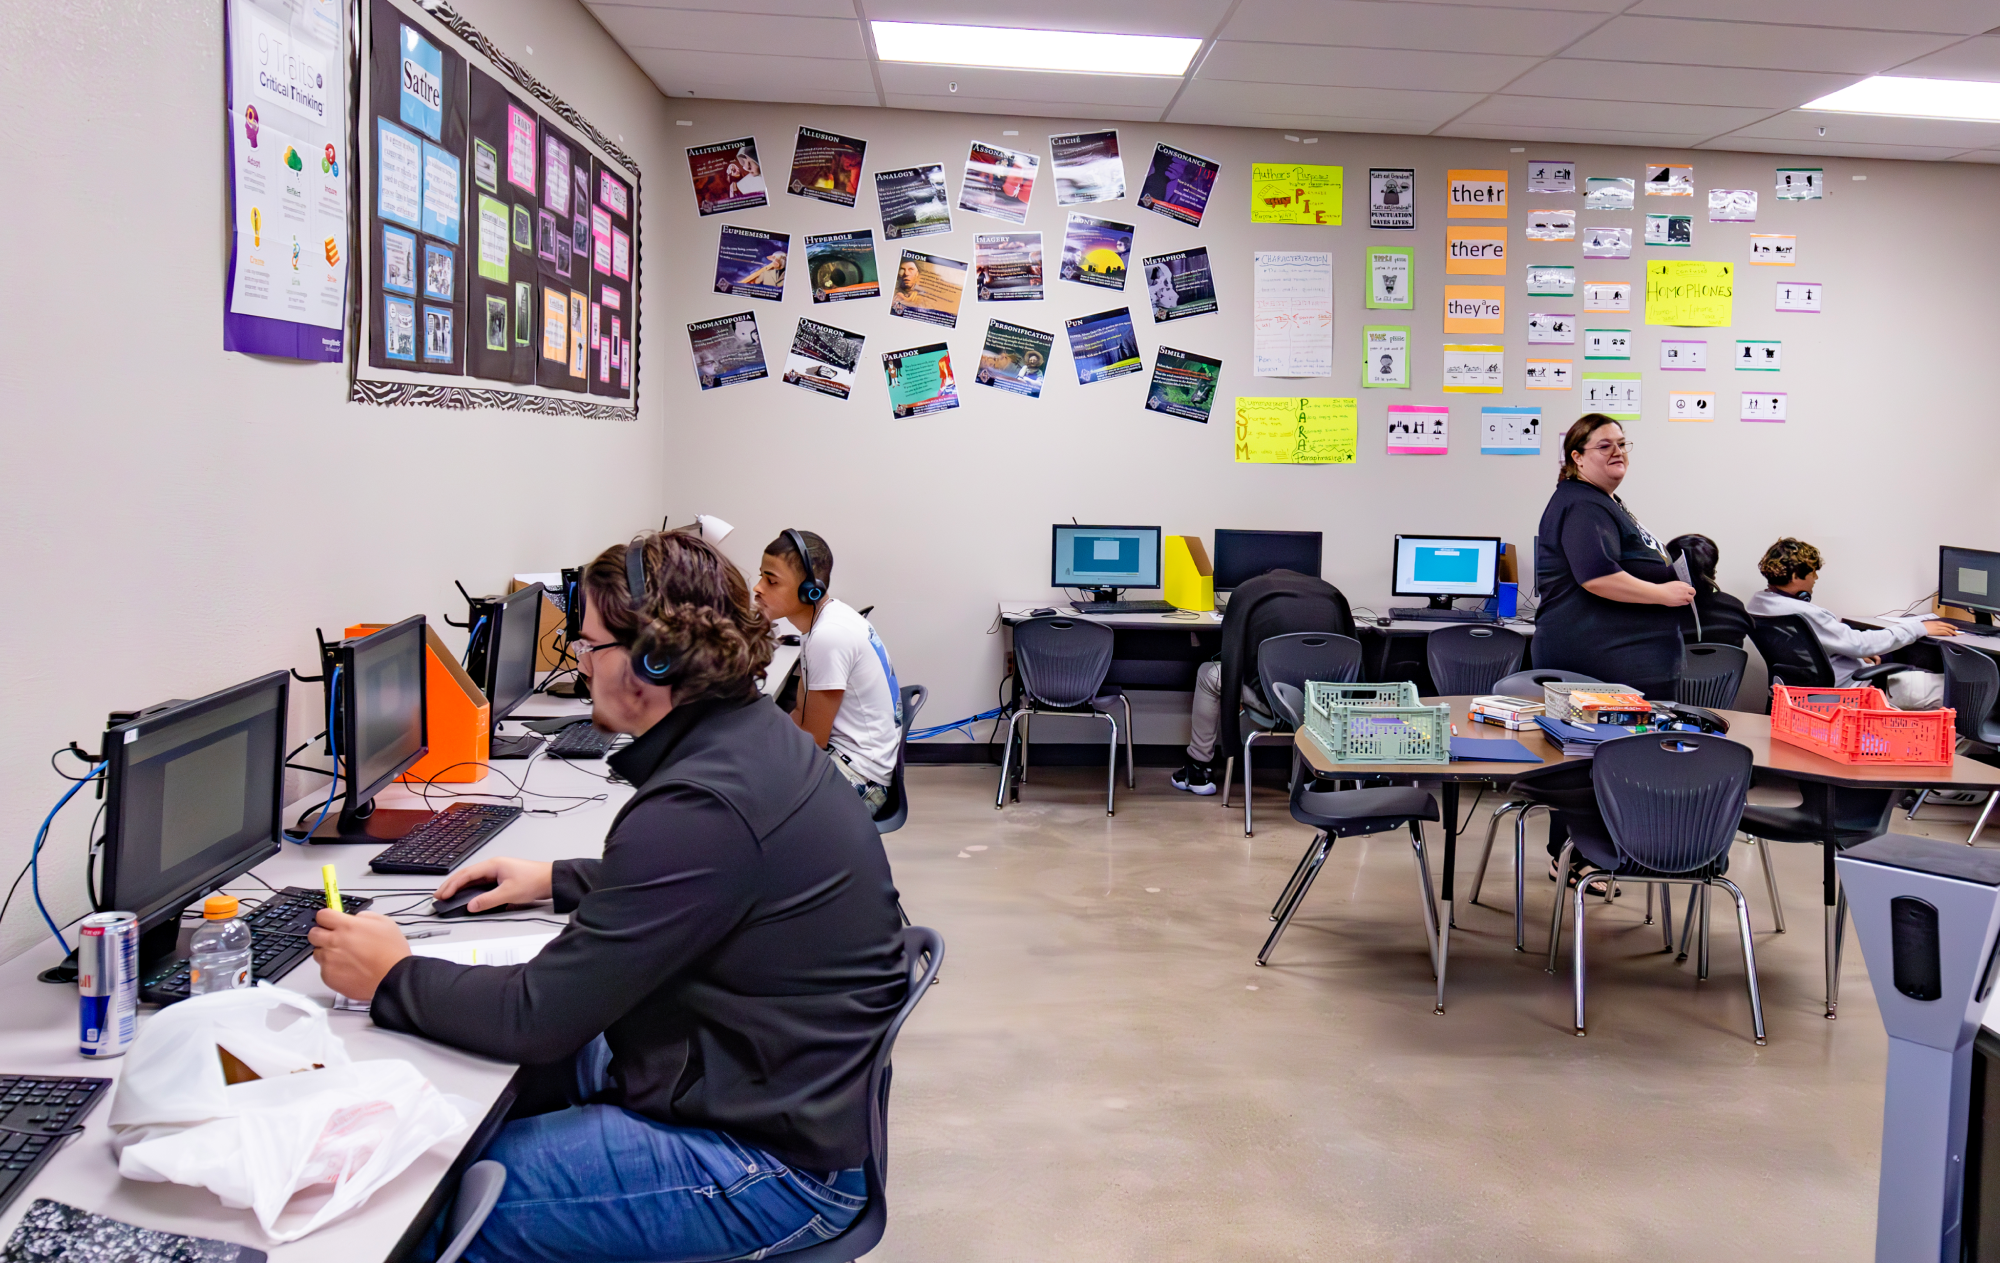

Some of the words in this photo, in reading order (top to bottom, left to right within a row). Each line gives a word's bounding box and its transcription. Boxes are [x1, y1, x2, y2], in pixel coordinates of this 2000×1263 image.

[258, 32, 268, 66] 9
[272, 38, 314, 89] Traits
[404, 60, 440, 107] Satire
[260, 71, 288, 98] Critical
[290, 85, 323, 117] Thinking
[800, 128, 840, 142] ALLUSION
[1052, 136, 1081, 146] CLICHÉ
[688, 142, 746, 156] ALLITERATION
[1158, 144, 1206, 168] CONSONANCE
[876, 170, 914, 181] ANALOGY
[1252, 167, 1290, 180] Author's
[1070, 214, 1094, 226] IRONY
[722, 226, 770, 240] EUPHEMISM
[806, 234, 852, 244] HYPERBOLE
[902, 250, 927, 262] IDIOM
[1451, 242, 1503, 257] there
[1144, 253, 1186, 266] METAPHOR
[1261, 254, 1328, 264] CHARACTERIZATION
[1647, 281, 1732, 302] HOMOPHONES
[689, 314, 752, 332] ONOMATOPOEIA
[800, 318, 845, 337] OXYMORON
[990, 318, 1053, 341] PERSONIFICATION
[1067, 320, 1084, 328] PUN
[883, 350, 919, 361] PARADOX
[1160, 346, 1185, 359] SIMILE
